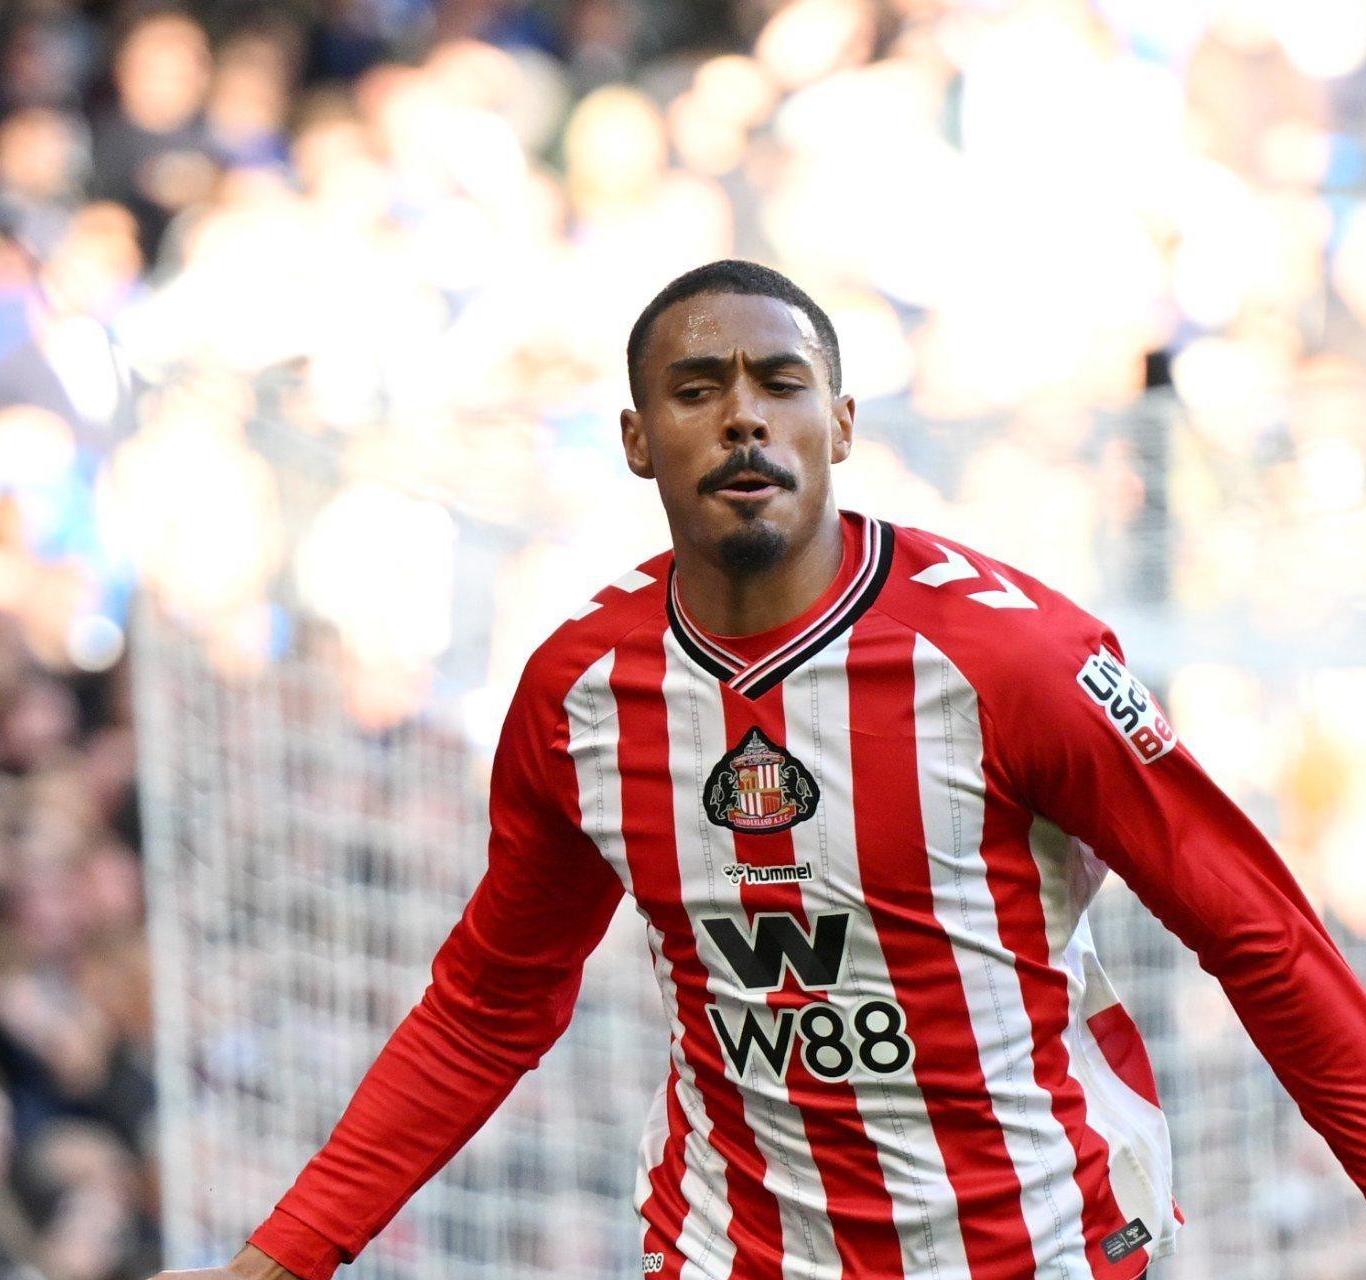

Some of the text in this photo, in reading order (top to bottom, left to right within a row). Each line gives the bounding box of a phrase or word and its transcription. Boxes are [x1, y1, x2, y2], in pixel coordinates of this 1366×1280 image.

[746, 861, 813, 882] hummel
[701, 912, 850, 989] W
[708, 1000, 911, 1078] W88
